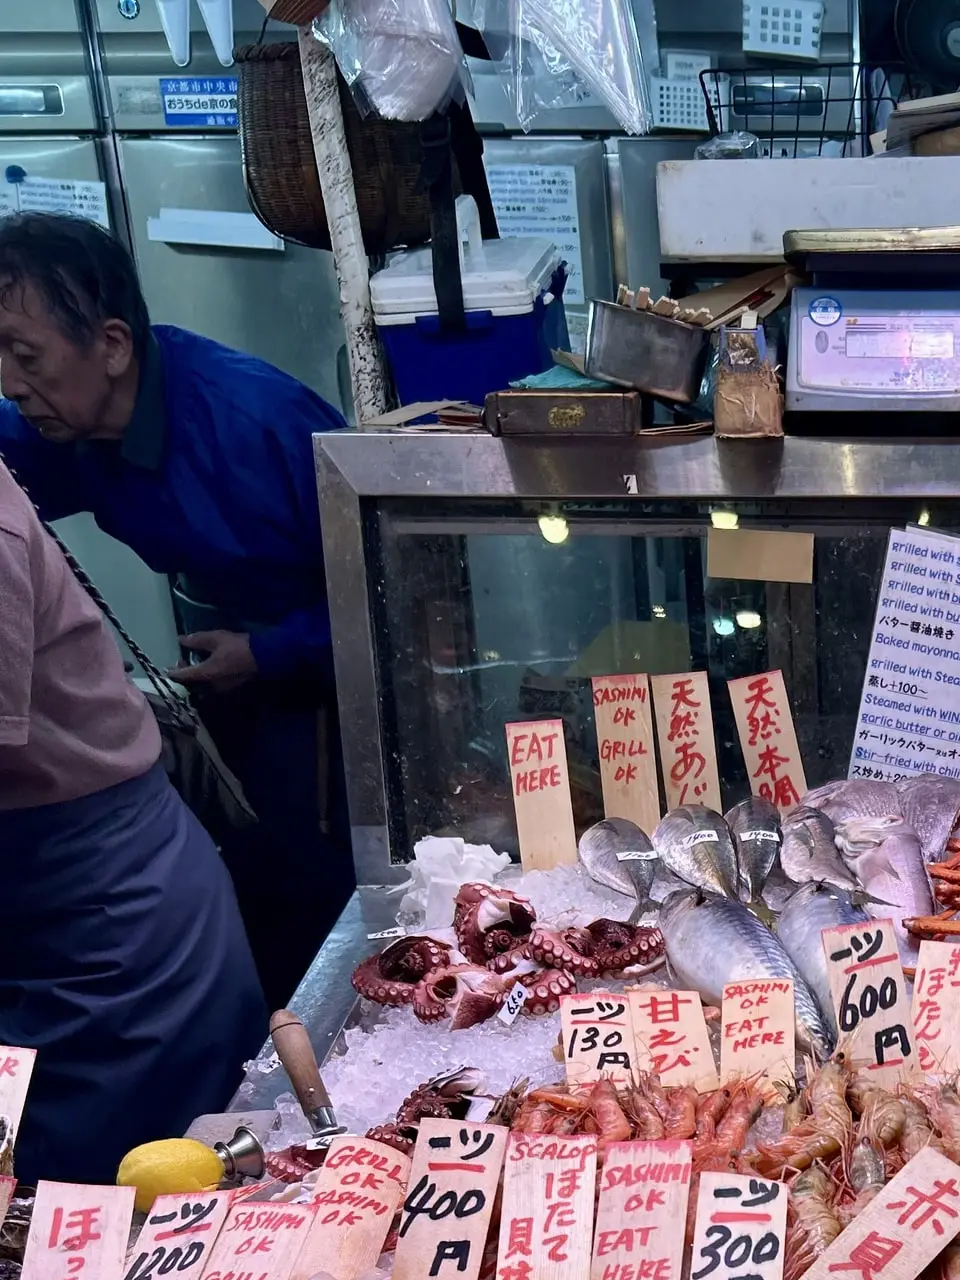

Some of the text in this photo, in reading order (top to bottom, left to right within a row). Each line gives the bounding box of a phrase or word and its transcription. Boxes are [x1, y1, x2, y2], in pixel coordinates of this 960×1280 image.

[888, 580, 924, 595] grilled
[926, 588, 950, 602] with
[865, 693, 911, 712] Steamed
[913, 705, 937, 718] with
[861, 712, 894, 728] garlic
[895, 718, 932, 735] butter
[933, 728, 947, 738] or
[511, 733, 559, 767] EAT
[855, 746, 960, 779] Stir-fried with chili
[516, 765, 561, 795] HERE
[840, 974, 898, 1032] 600
[568, 1027, 623, 1058] 130
[639, 993, 701, 1075] 甘えび
[510, 1141, 597, 1171] SCALOP
[602, 1162, 689, 1191] SASHIMI
[399, 1174, 486, 1238] 400
[541, 1171, 582, 1262] ほたて
[692, 1224, 780, 1280] 300
